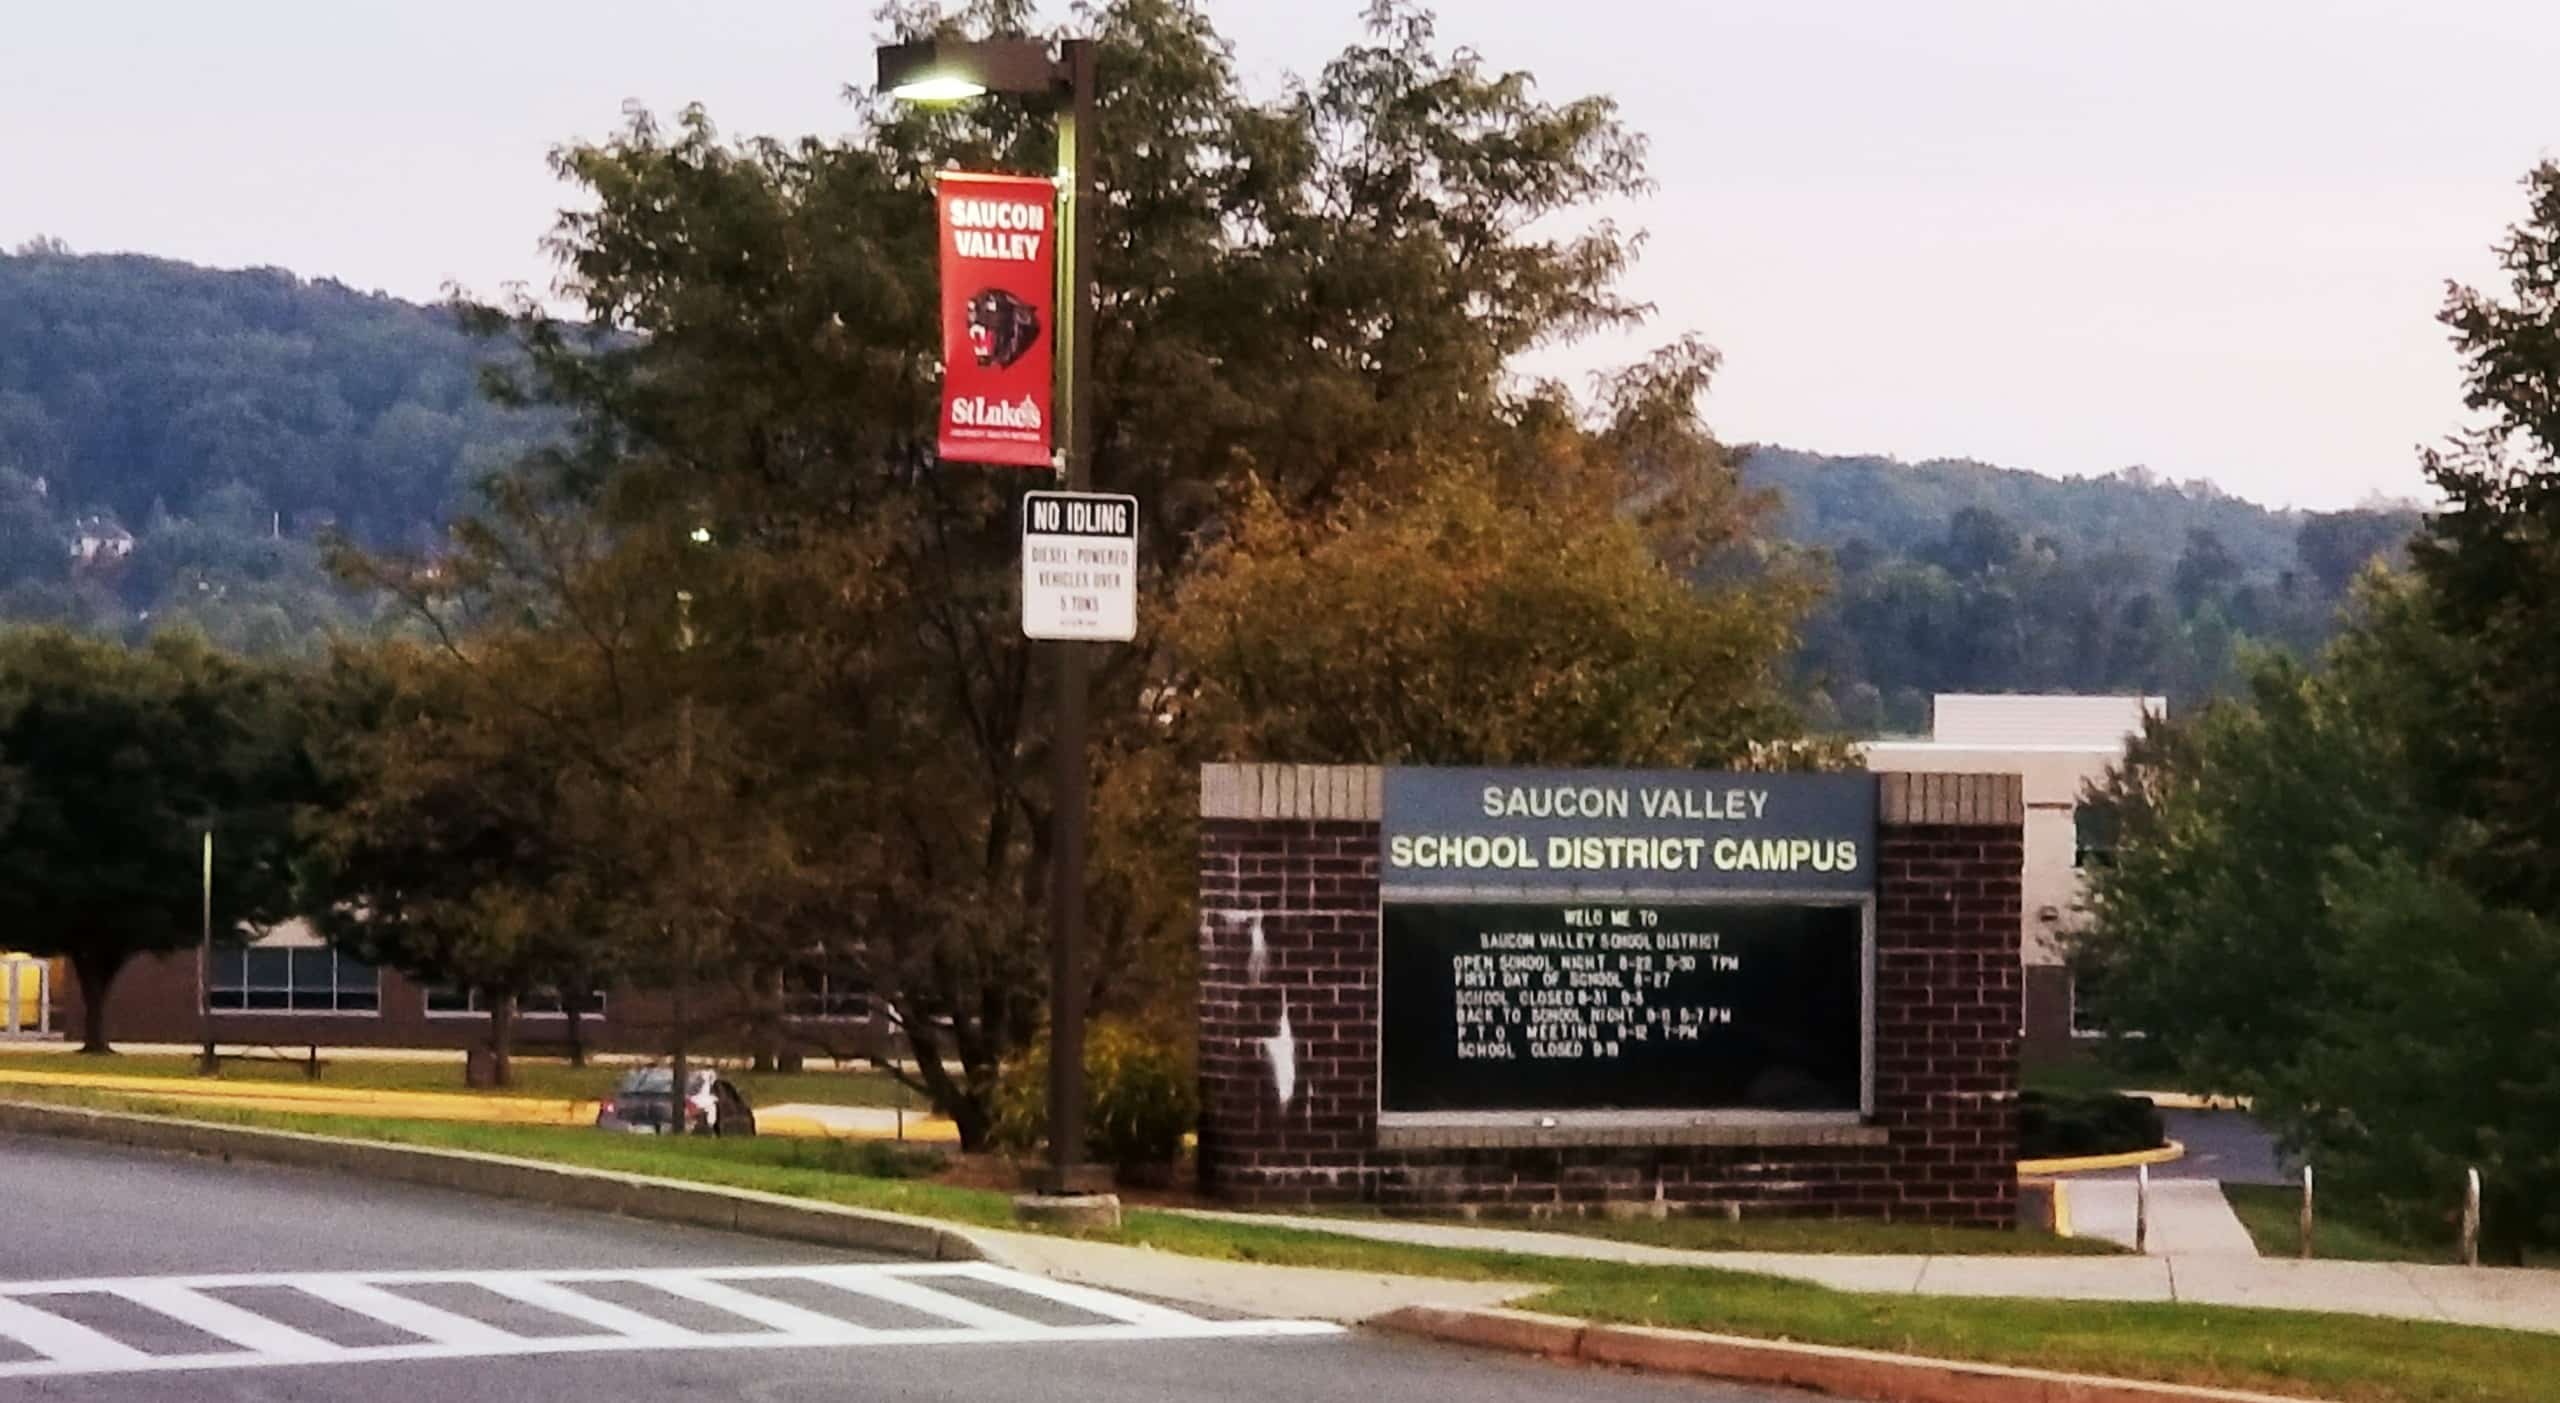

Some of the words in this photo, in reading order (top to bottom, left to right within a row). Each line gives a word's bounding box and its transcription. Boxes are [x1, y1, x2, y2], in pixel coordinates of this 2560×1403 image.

[951, 198, 1044, 231] SAUCON
[954, 230, 1040, 261] VALLEY
[1034, 501, 1060, 531] NO
[1067, 502, 1126, 533] IDLING
[1483, 786, 1629, 817] SAUCON
[1640, 788, 1768, 819] VALLEY
[1391, 835, 1539, 868] SCHOOL
[1548, 836, 1705, 870] DISTRICT
[1713, 838, 1858, 871] CAMPUS
[1639, 909, 1658, 927] TO
[1480, 932, 1535, 949] SAUCON
[1539, 932, 1595, 949] VALLEY
[1600, 932, 1653, 950] SCHOOL
[1656, 932, 1720, 950] DISTRICT
[1453, 954, 1494, 971] OPEN
[1499, 954, 1554, 972] SCHOOL
[1561, 954, 1605, 972] NIGHT
[1454, 970, 1496, 987] FIRST
[1503, 970, 1529, 987] DAY
[1542, 970, 1560, 987] OF
[1569, 970, 1624, 988] SCHOOL
[1456, 989, 1508, 1007] SCHOOL
[1519, 989, 1575, 1006] CLOSED
[1456, 1007, 1494, 1024] BACK
[1503, 1007, 1521, 1024] TO
[1531, 1007, 1584, 1025] SCHOOL
[1590, 1007, 1634, 1024] NIGHT
[1526, 1024, 1598, 1041] MEETING
[1457, 1041, 1516, 1059] SCHOOL
[1530, 1041, 1584, 1059] CLOSED
